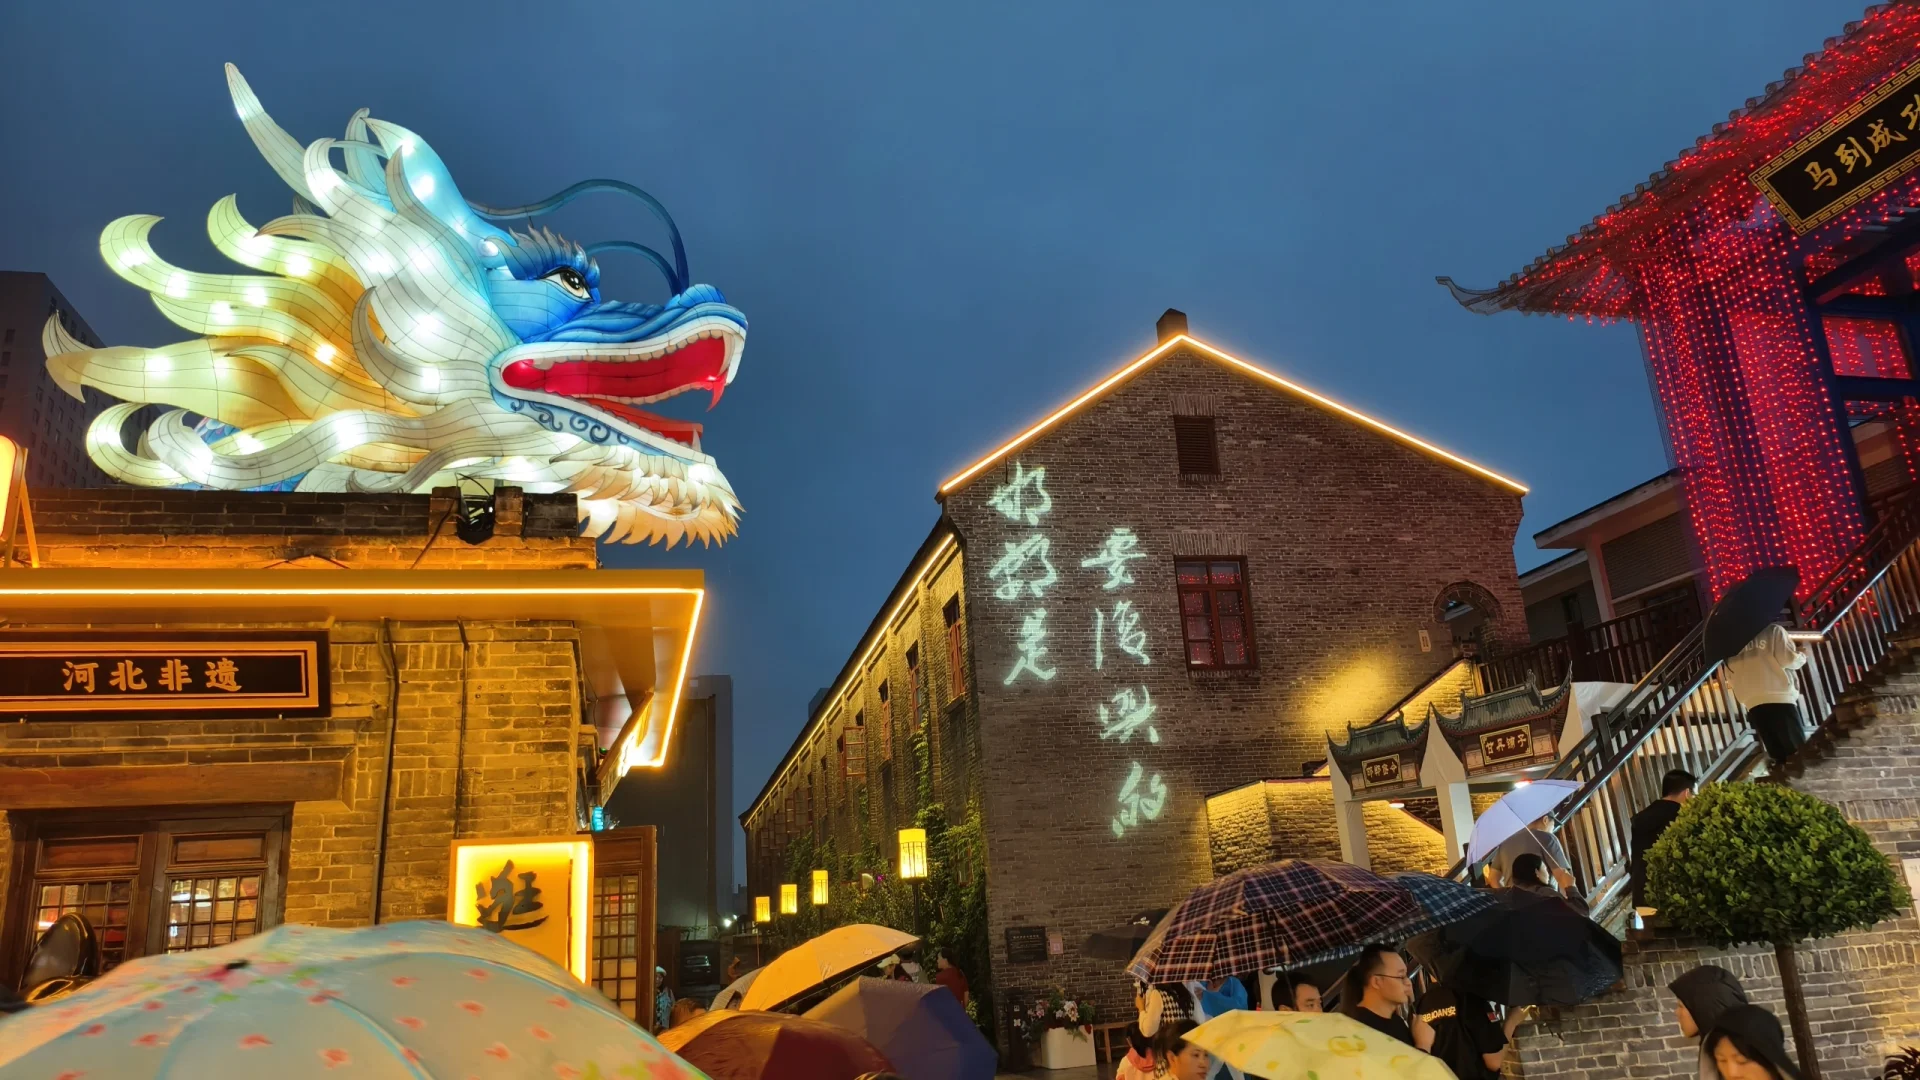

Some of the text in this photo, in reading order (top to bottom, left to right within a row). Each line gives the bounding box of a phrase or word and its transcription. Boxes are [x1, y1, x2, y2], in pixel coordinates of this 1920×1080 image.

[62, 657, 242, 693] 河北非遗
[475, 859, 549, 933] 逛
